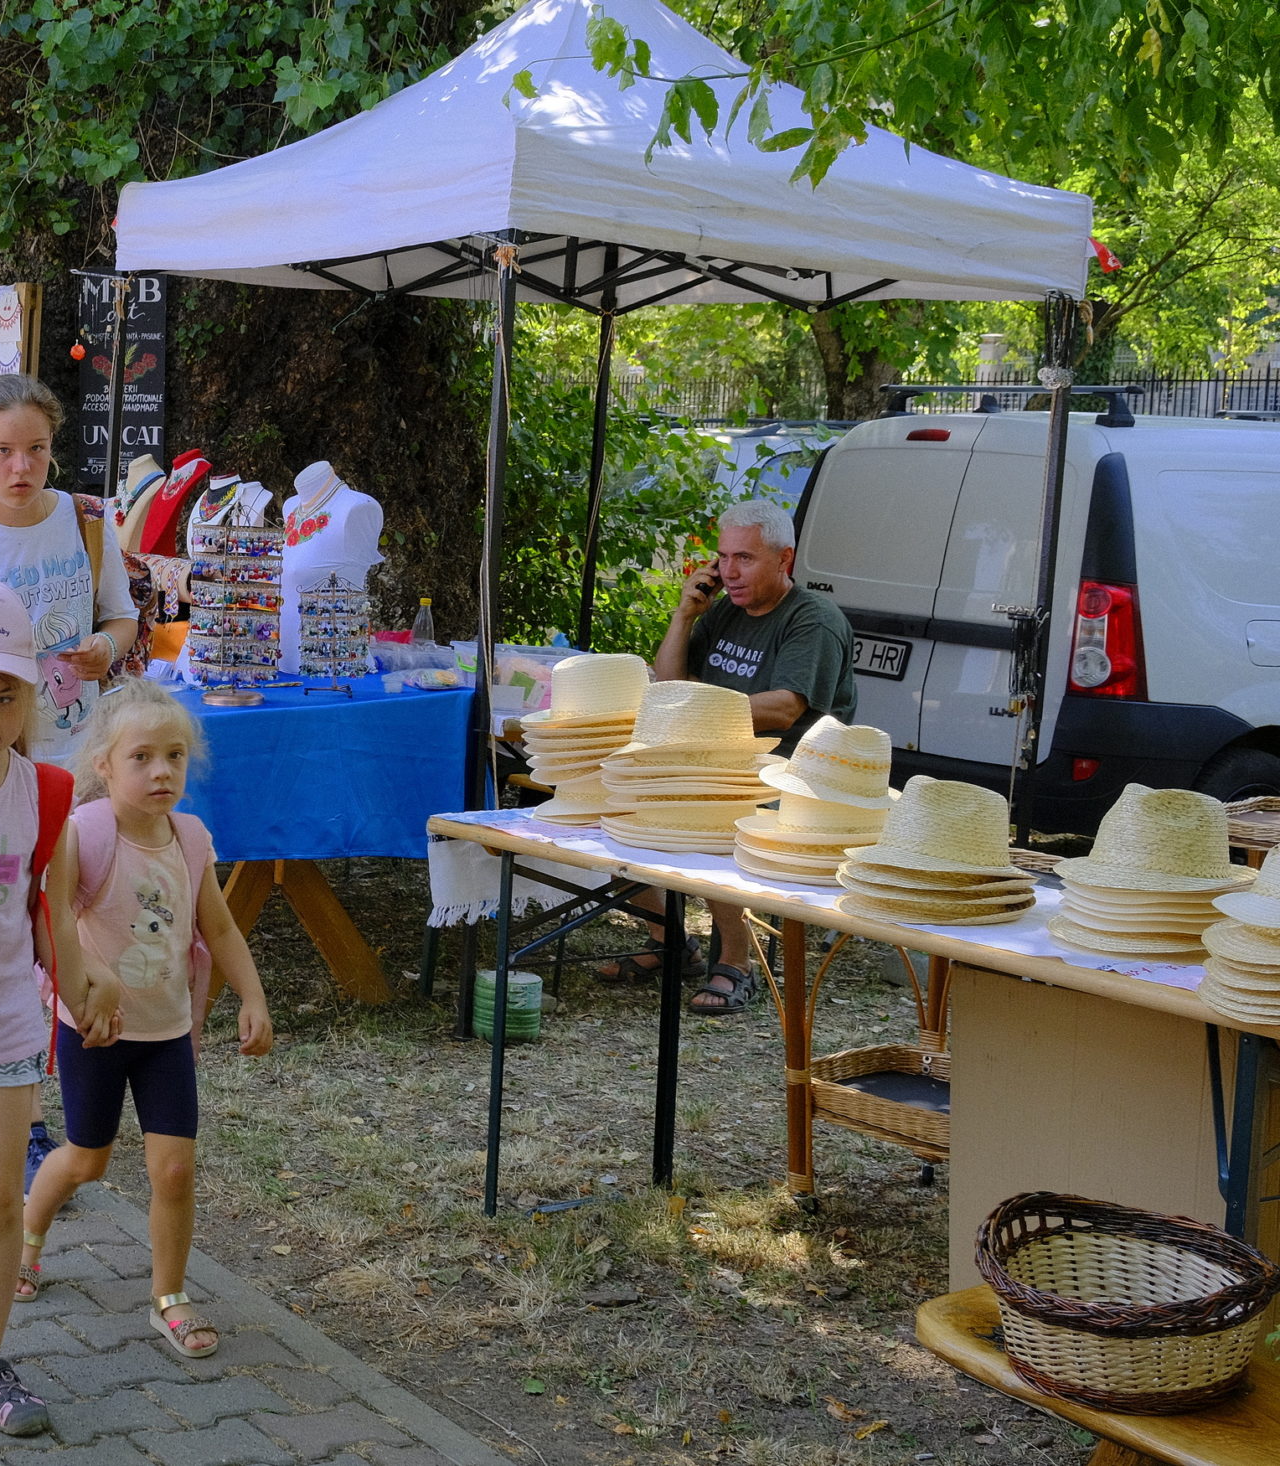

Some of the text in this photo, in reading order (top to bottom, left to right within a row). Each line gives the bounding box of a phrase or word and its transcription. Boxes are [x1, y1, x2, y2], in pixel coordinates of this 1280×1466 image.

[100, 303, 146, 323] at
[122, 403, 159, 412] HANDMADE
[83, 425, 163, 446] UNCAT
[806, 582, 834, 593] DACIA
[869, 643, 904, 672] HRI
